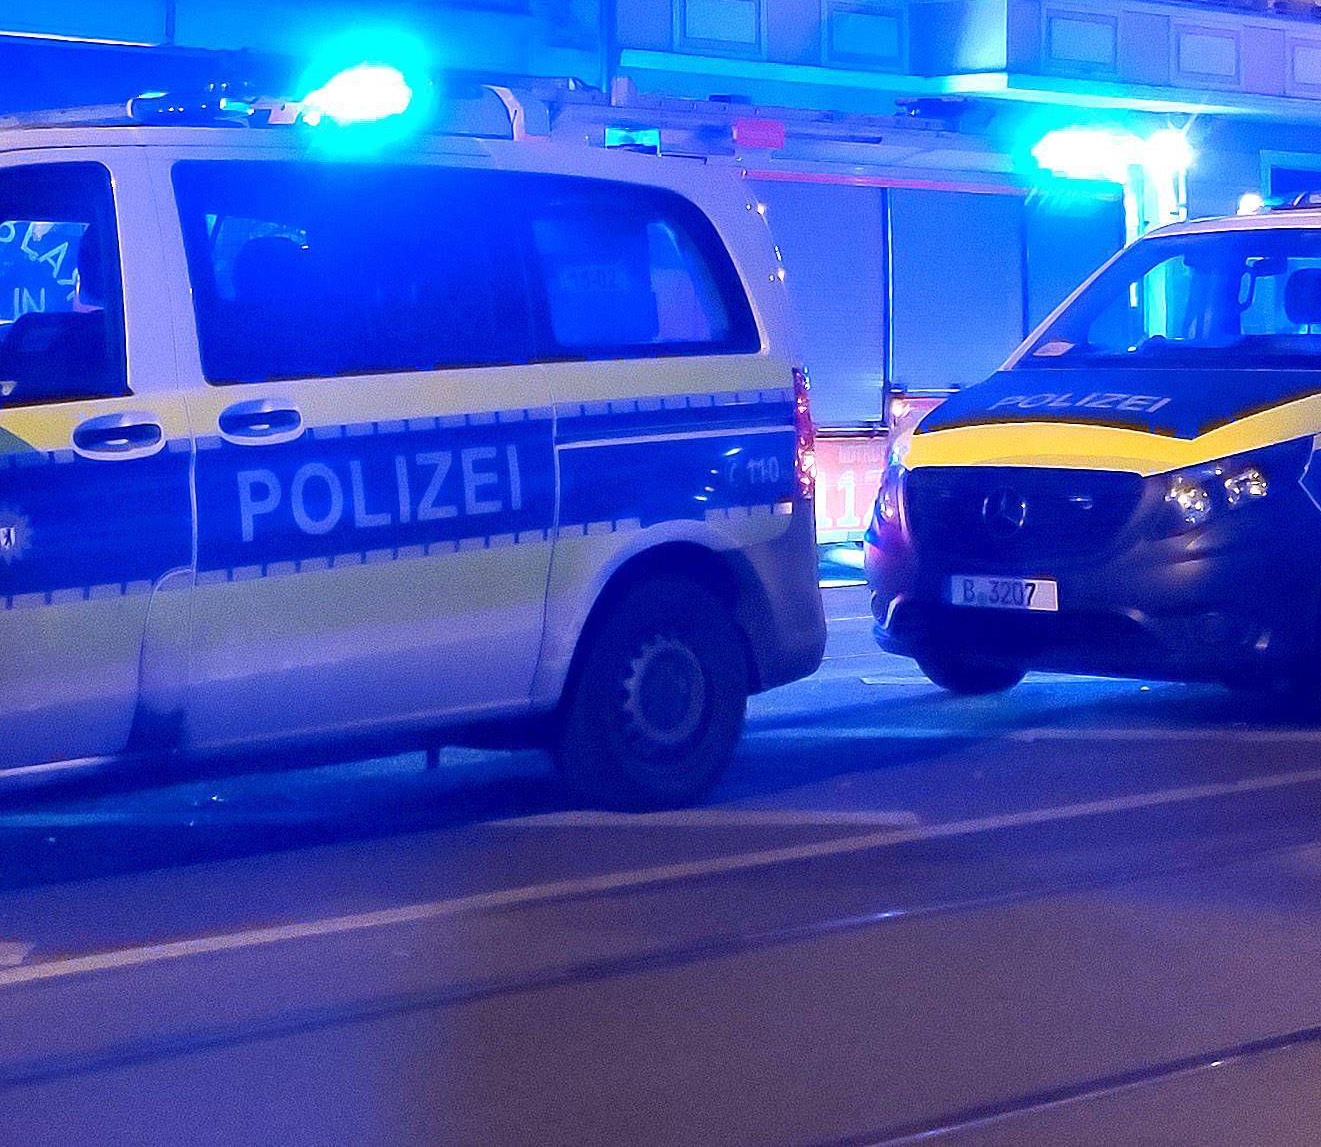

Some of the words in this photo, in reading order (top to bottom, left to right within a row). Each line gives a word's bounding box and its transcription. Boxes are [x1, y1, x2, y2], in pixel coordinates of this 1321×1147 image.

[986, 392, 1172, 414] POLIZEI
[746, 456, 780, 484] 110
[237, 444, 522, 542] POLIZEI
[988, 580, 1036, 606] 3207
